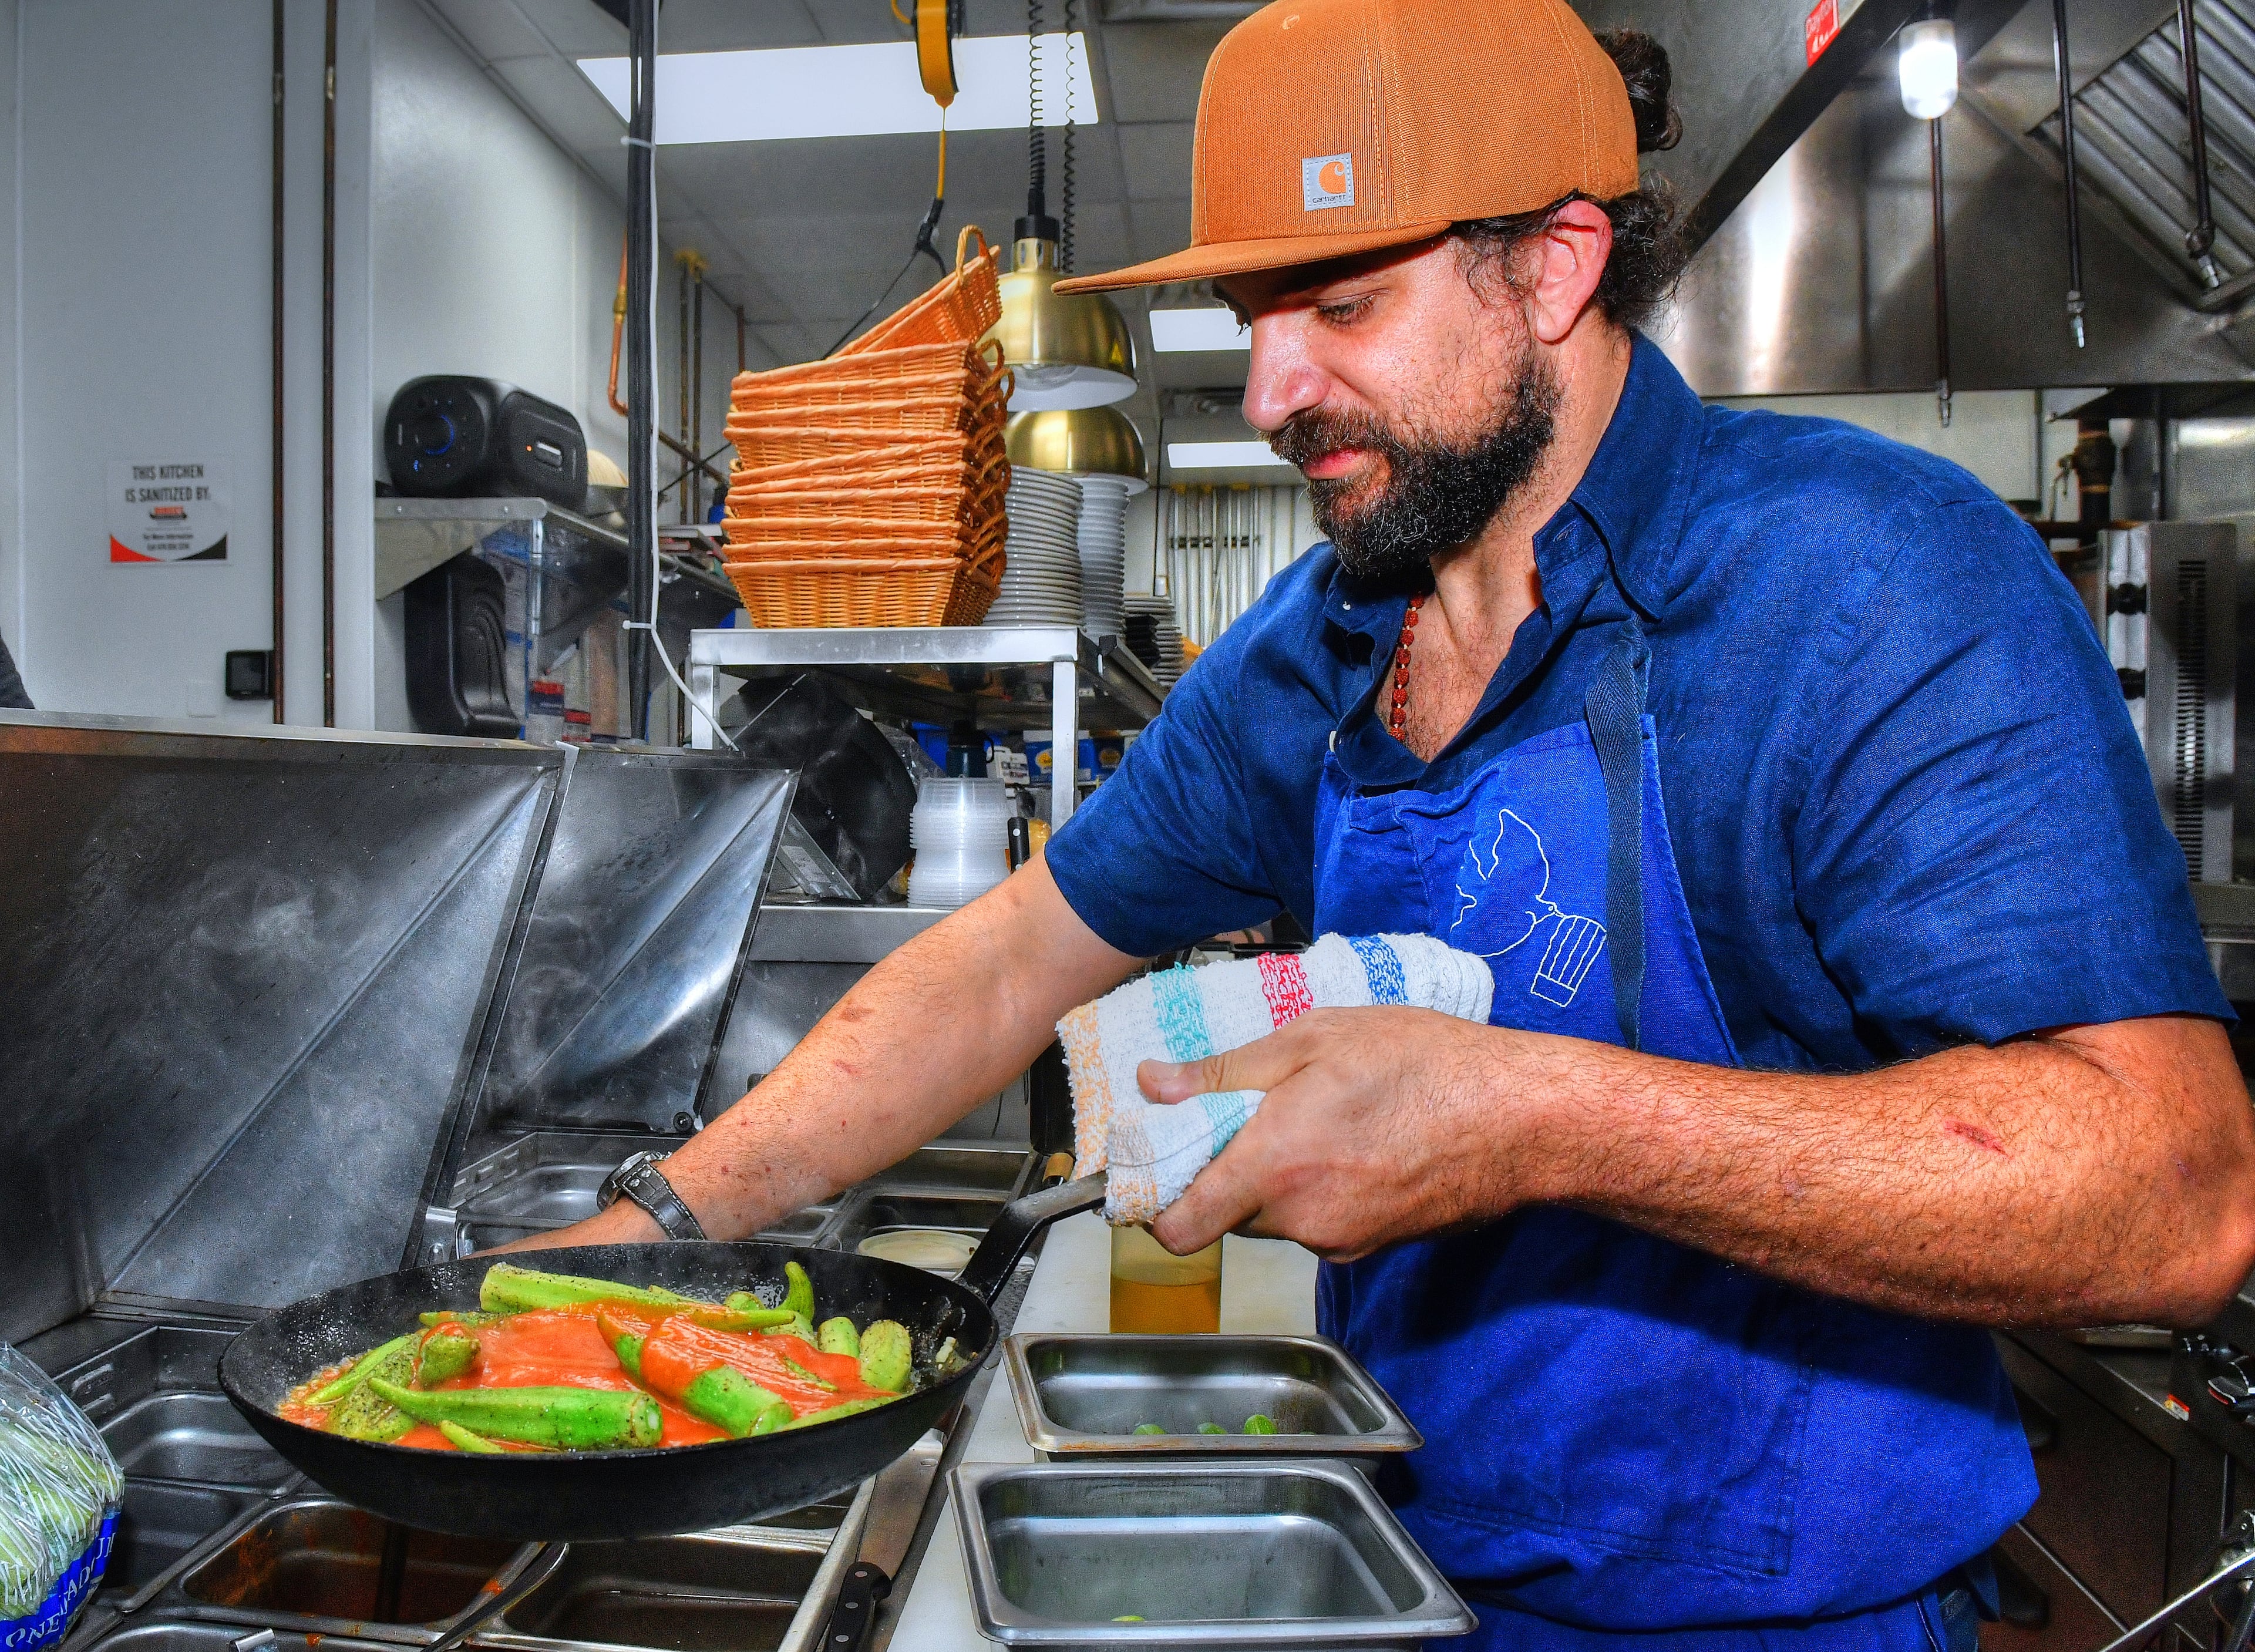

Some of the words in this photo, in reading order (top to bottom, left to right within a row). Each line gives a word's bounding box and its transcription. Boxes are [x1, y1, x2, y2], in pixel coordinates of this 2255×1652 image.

[1312, 194, 1346, 203] carhartt
[133, 466, 156, 479] THIS
[160, 465, 203, 479] KITCHEN
[124, 488, 136, 502] IS
[140, 486, 193, 502] SANITIZED
